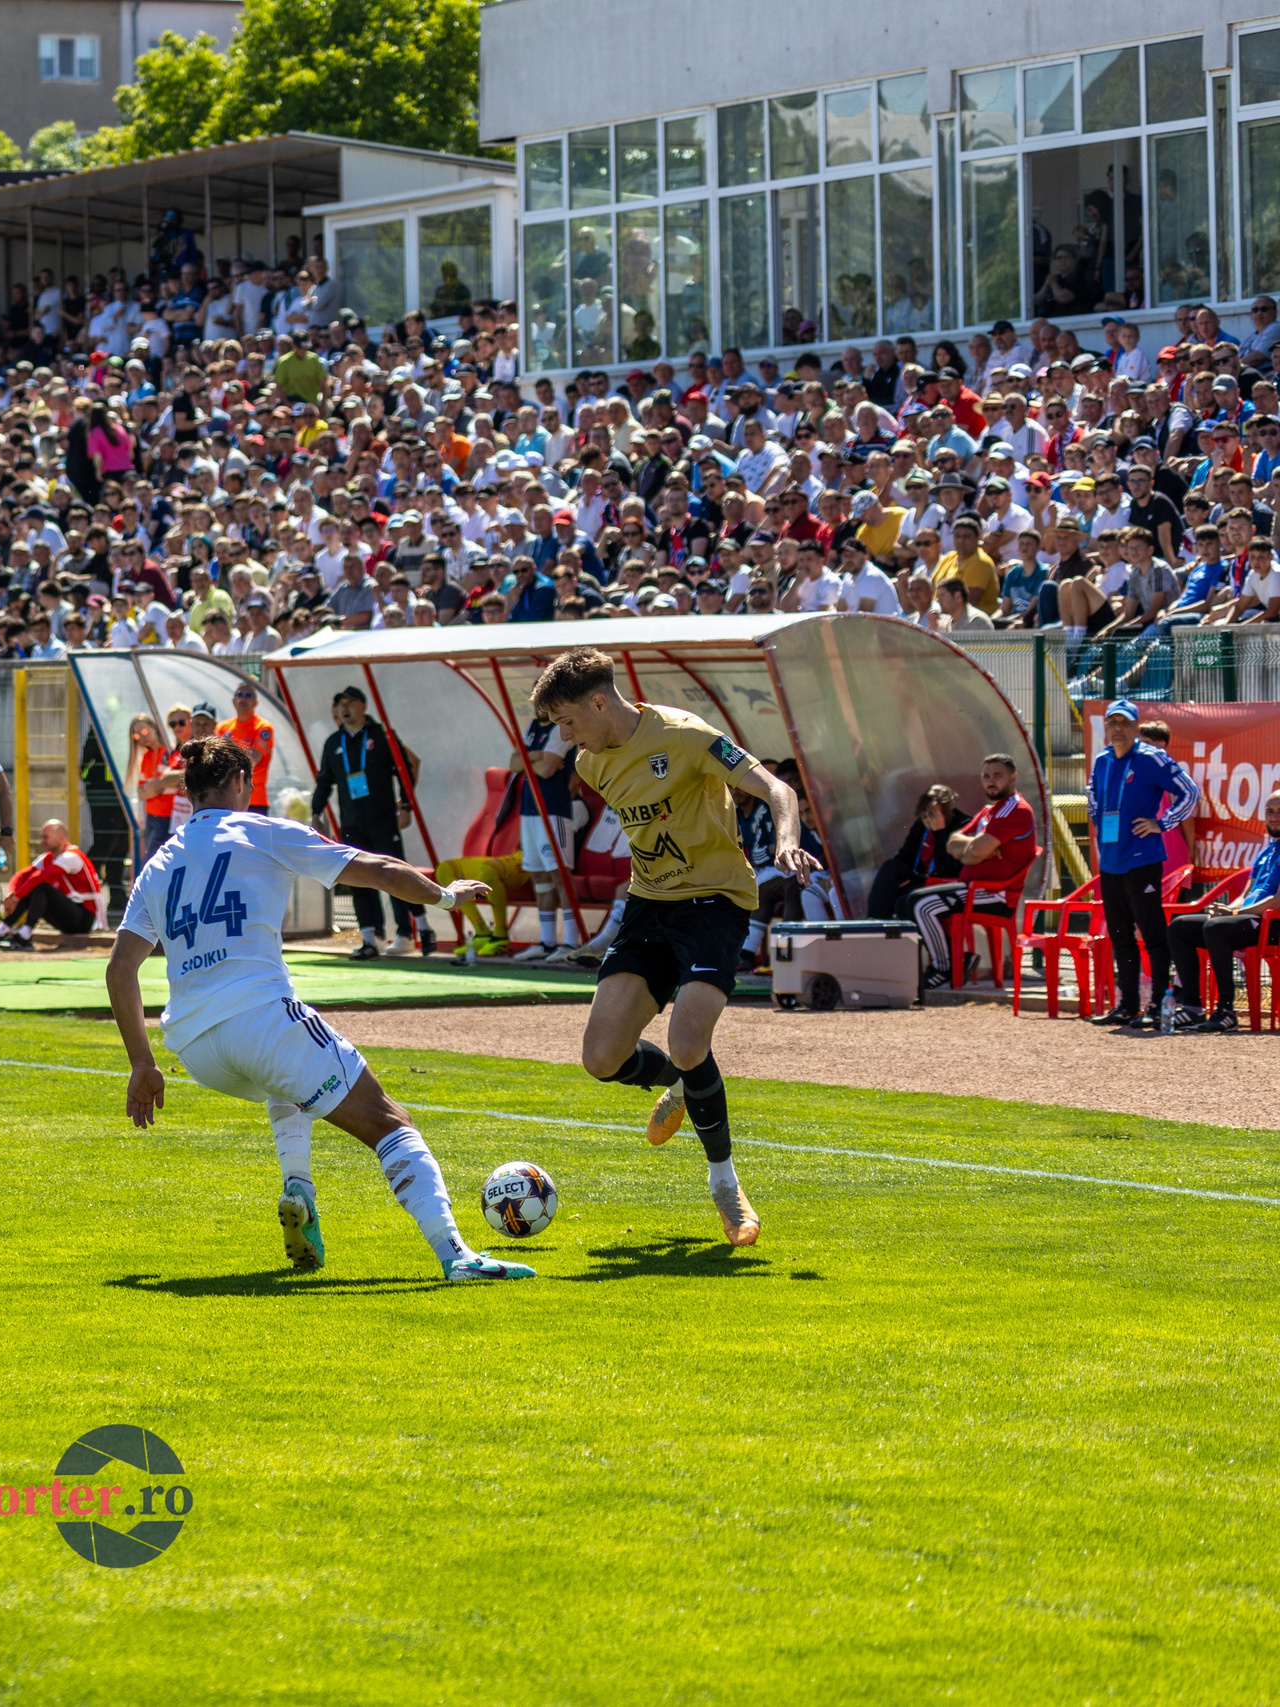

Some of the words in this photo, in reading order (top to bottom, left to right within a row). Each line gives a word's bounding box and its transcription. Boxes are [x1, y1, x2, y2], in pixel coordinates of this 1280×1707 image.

[616, 797, 673, 824] AXBET
[165, 851, 247, 950] 44
[300, 1088, 324, 1109] Smart
[322, 1074, 337, 1092] Eco
[329, 1079, 342, 1094] Plus
[488, 1181, 524, 1200] SELECT
